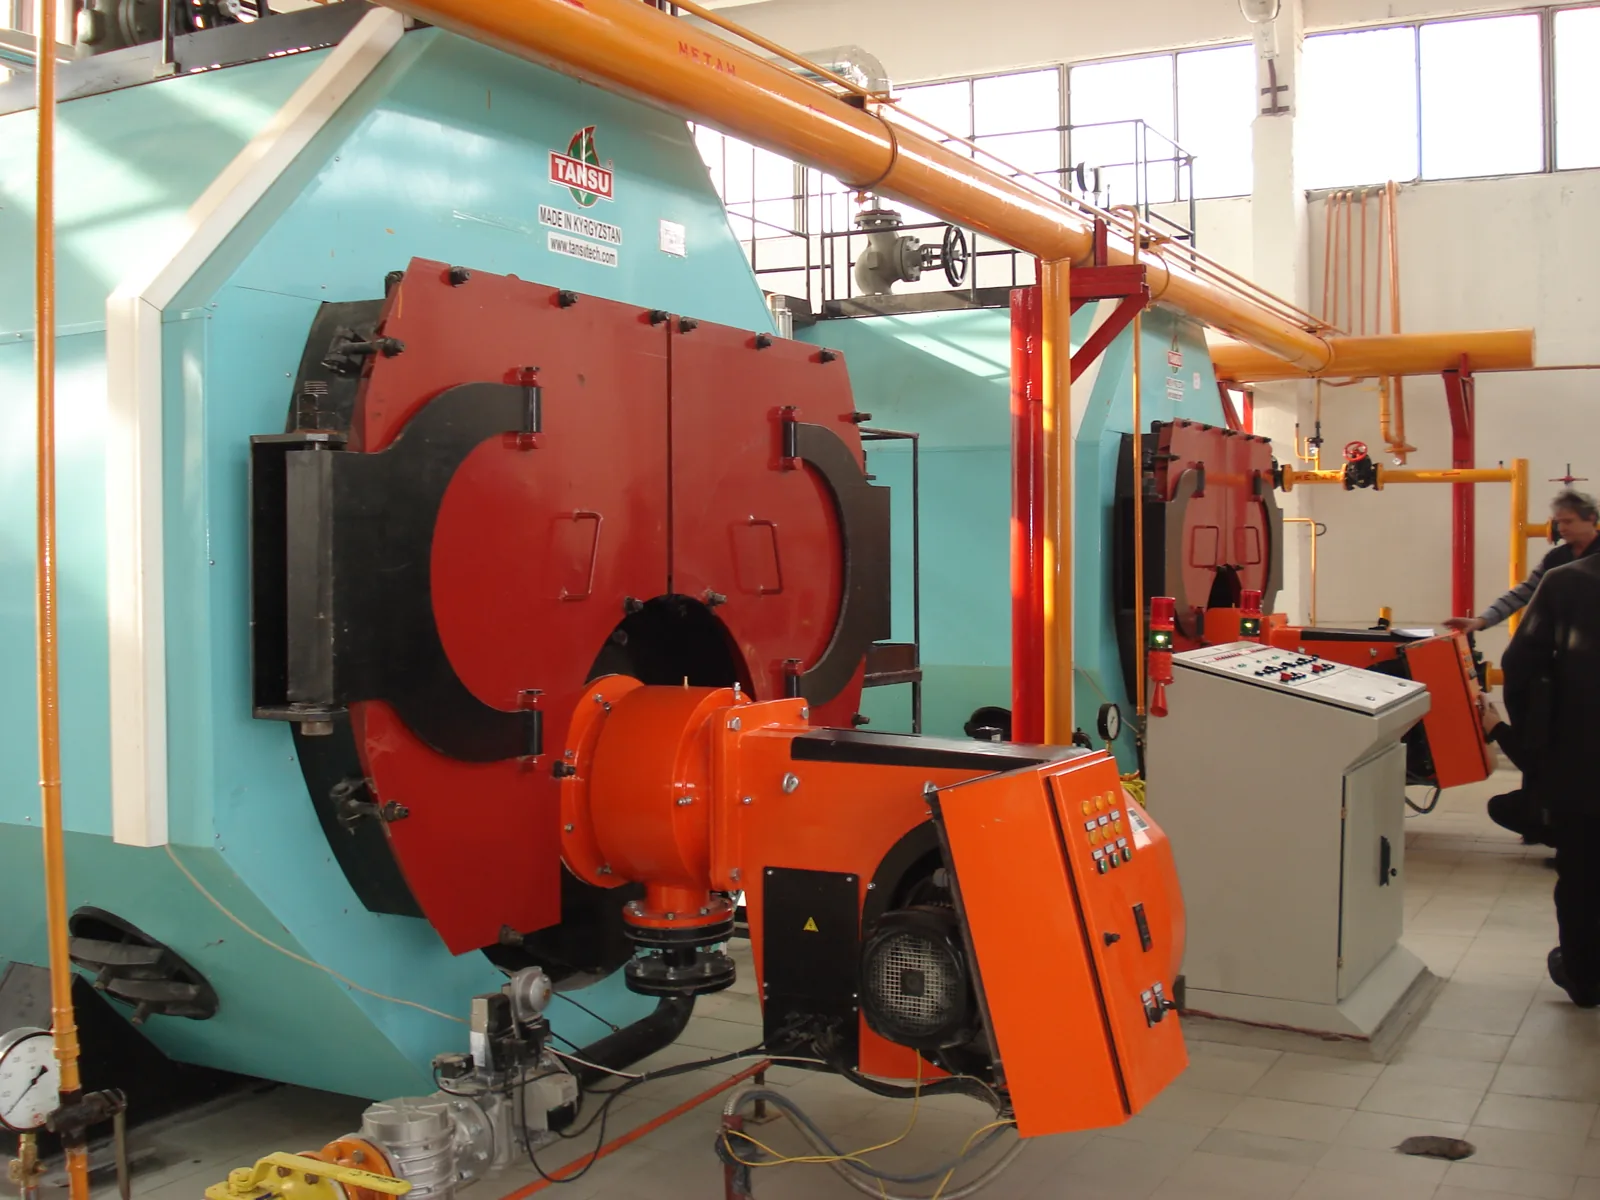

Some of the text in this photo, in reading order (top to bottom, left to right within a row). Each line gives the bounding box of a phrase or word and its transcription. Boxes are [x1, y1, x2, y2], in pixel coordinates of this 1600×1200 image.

[554, 157, 610, 193] TANSU
[540, 206, 621, 244] MADE IN KYRGYZSTAN
[550, 238, 616, 265] www.tansutech.com
